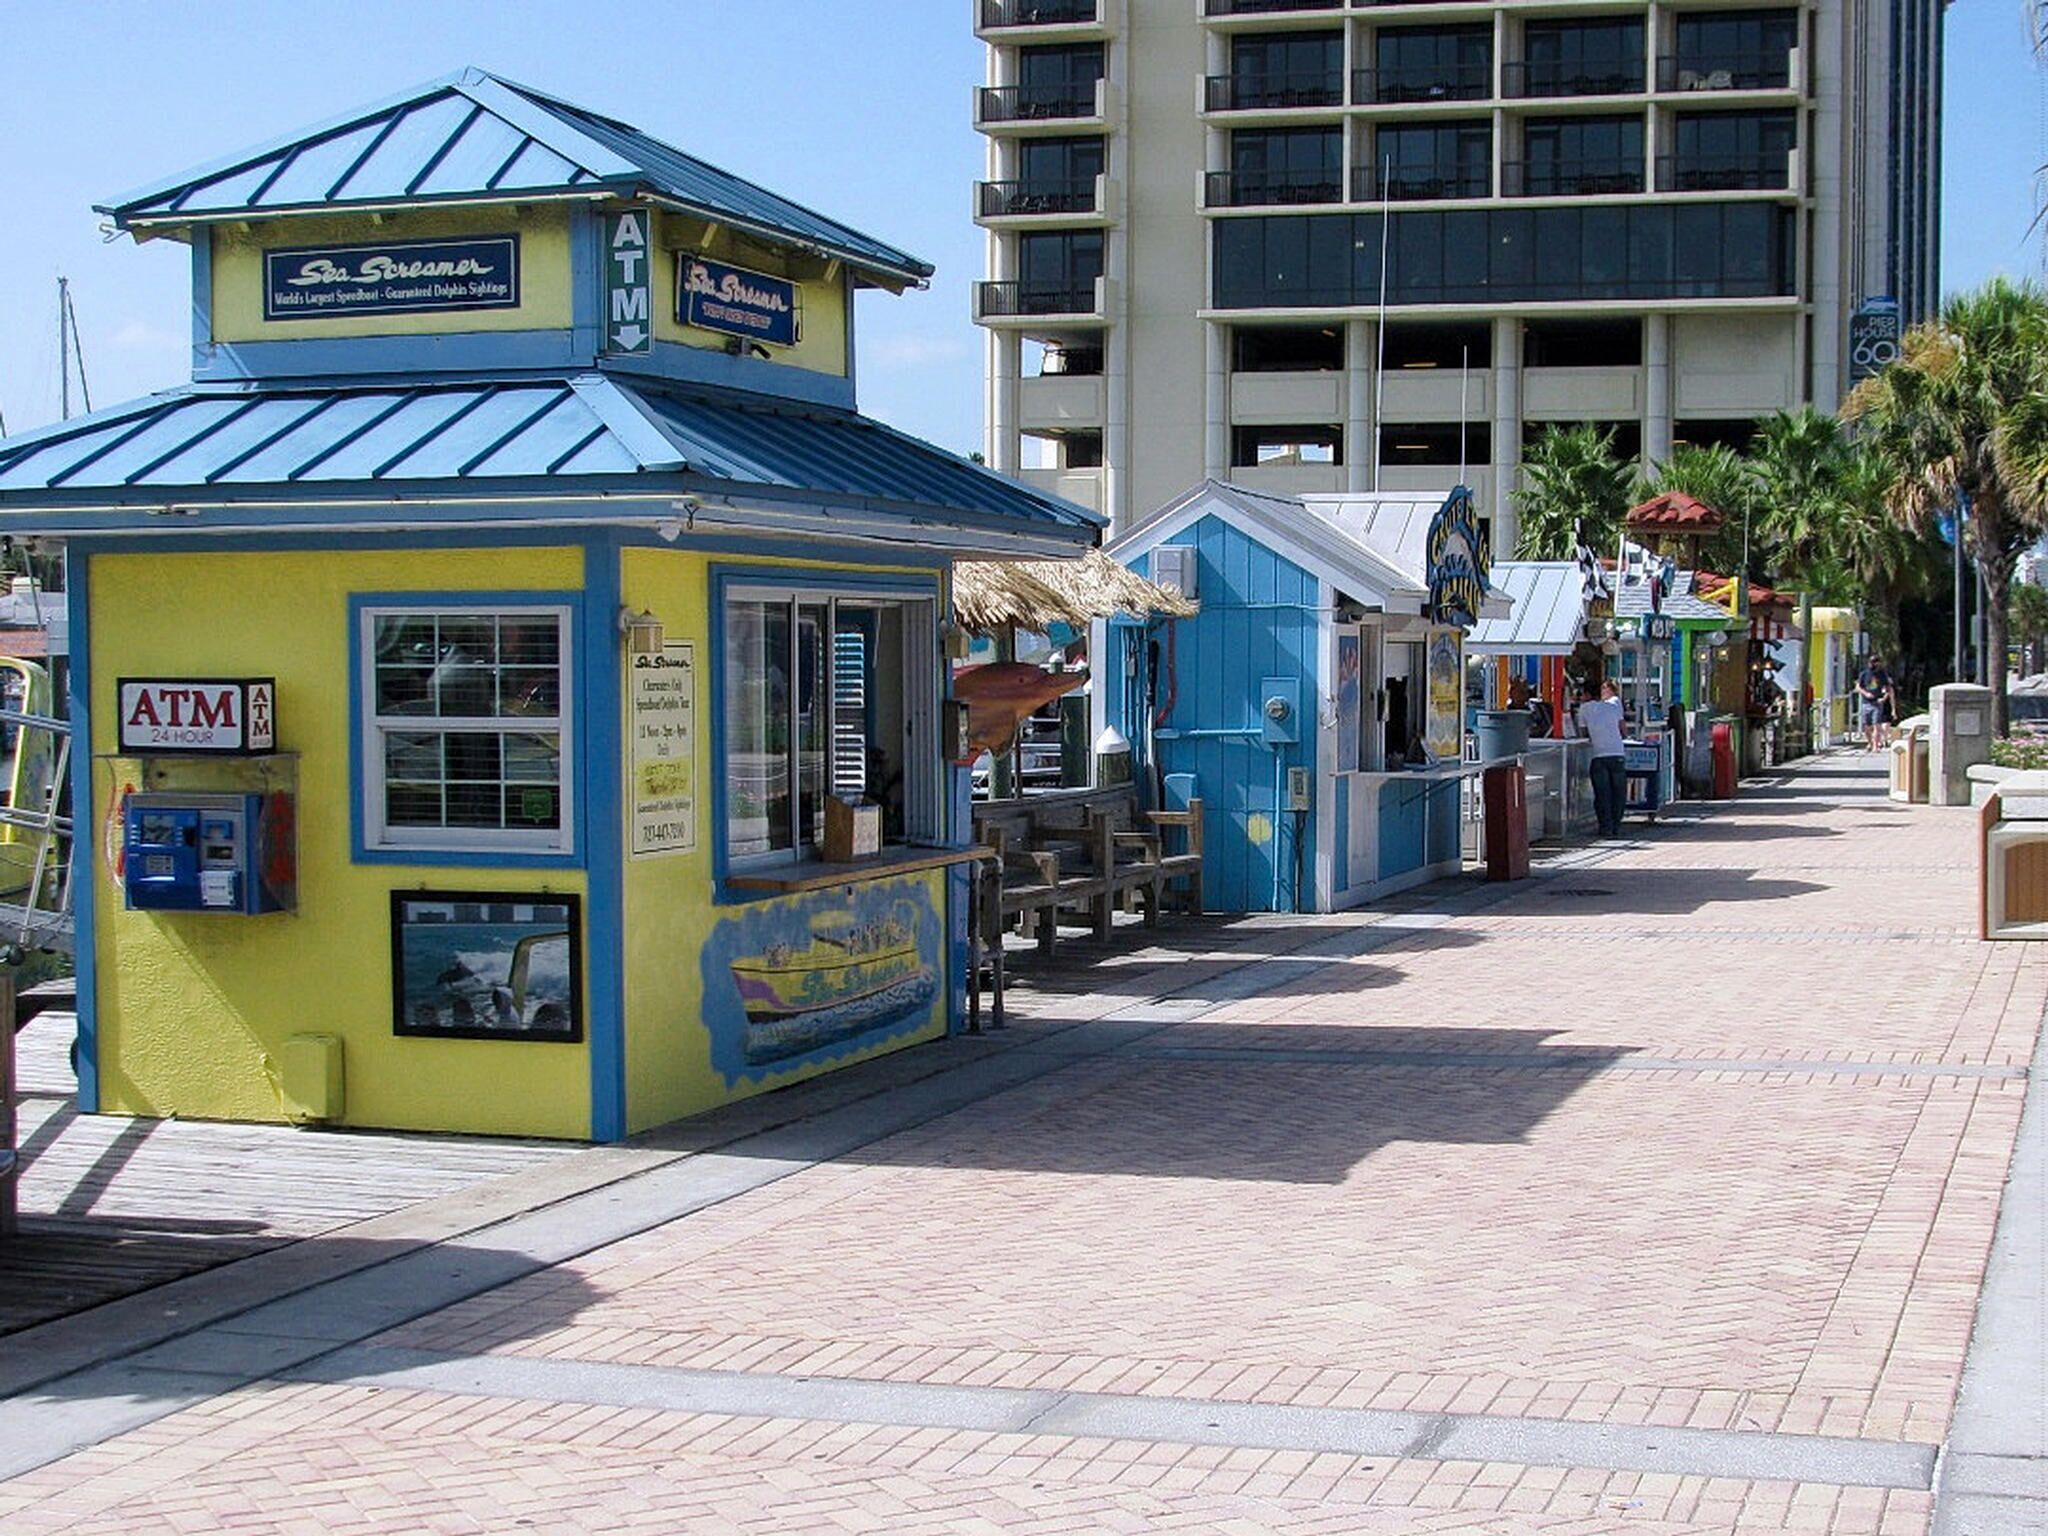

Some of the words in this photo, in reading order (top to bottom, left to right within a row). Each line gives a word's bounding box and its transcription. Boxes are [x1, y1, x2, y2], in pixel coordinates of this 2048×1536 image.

[288, 258, 351, 286] Sea
[351, 255, 494, 284] Screamer
[612, 213, 647, 322] ATM
[274, 291, 304, 305] World's
[304, 290, 335, 307] Largest
[335, 288, 379, 305] Speedboat
[385, 285, 433, 300] Guaranteed
[434, 283, 468, 299] Dolphin
[469, 282, 508, 298] Sightings
[1853, 326, 1896, 339] HOUSE
[1853, 338, 1897, 365] 60
[127, 688, 236, 729] ATM
[253, 687, 270, 737] ATM
[151, 728, 169, 743] 24
[174, 729, 214, 744] HOUR
